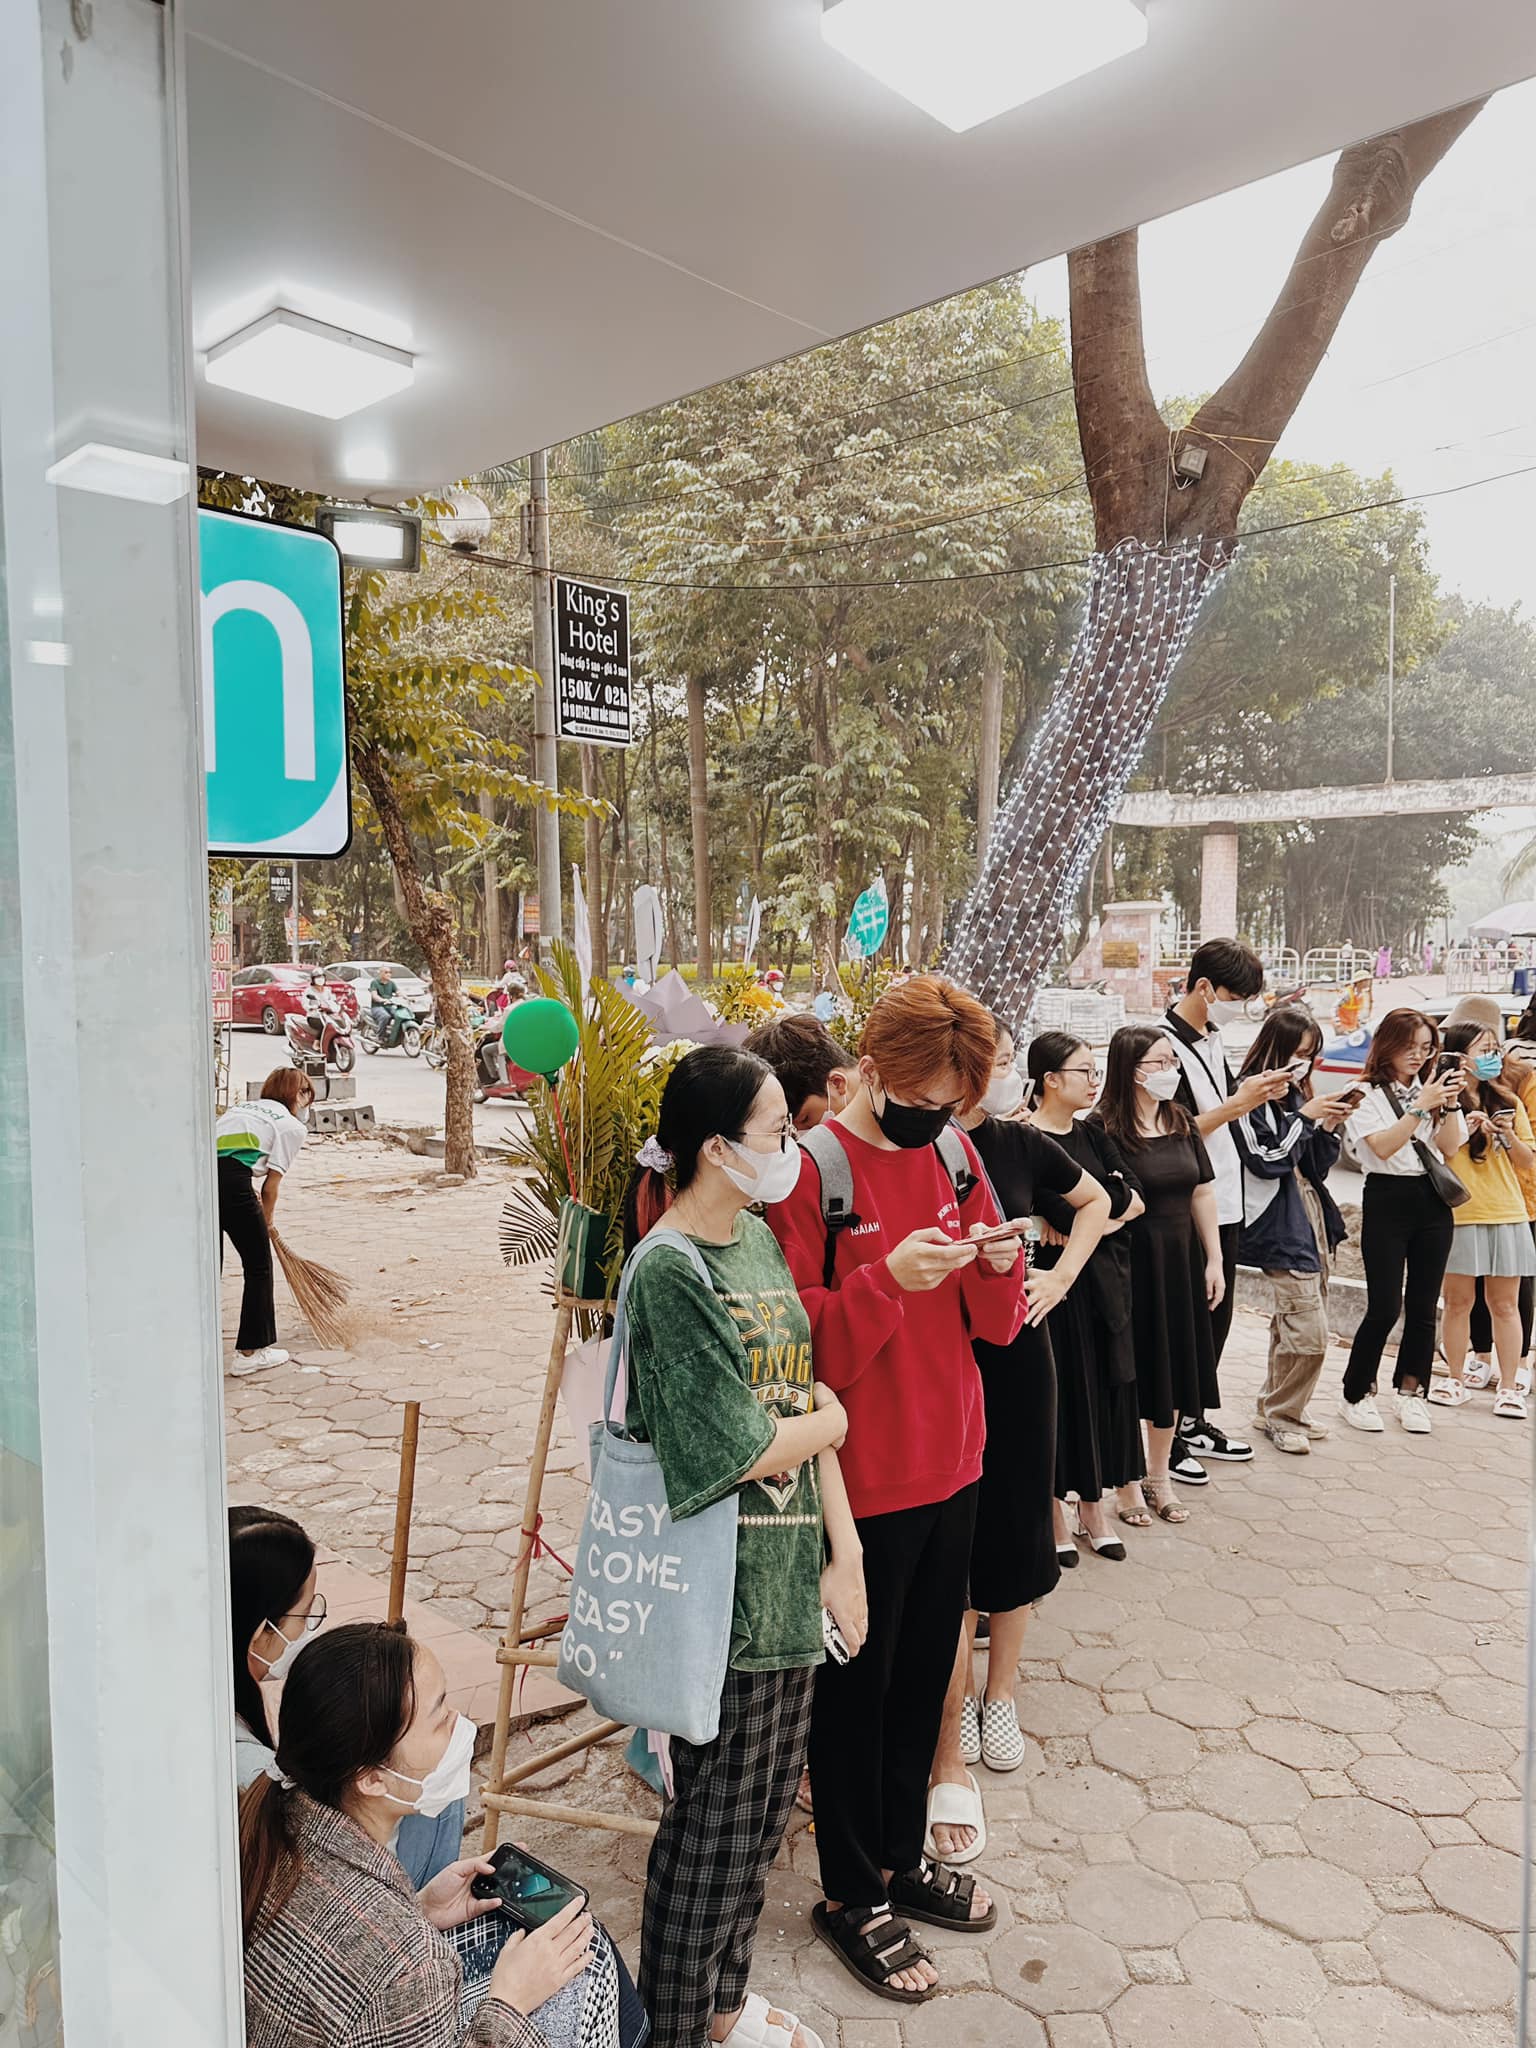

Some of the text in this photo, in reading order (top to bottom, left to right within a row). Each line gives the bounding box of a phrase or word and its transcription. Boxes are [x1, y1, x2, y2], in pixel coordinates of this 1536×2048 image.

[565, 583, 620, 627] King's
[569, 620, 618, 656] Hotel
[561, 677, 628, 707] 150K/ 02h
[850, 1221, 880, 1237] ISAIAH
[587, 1543, 690, 1595] COME,
[574, 1585, 654, 1636] EASY
